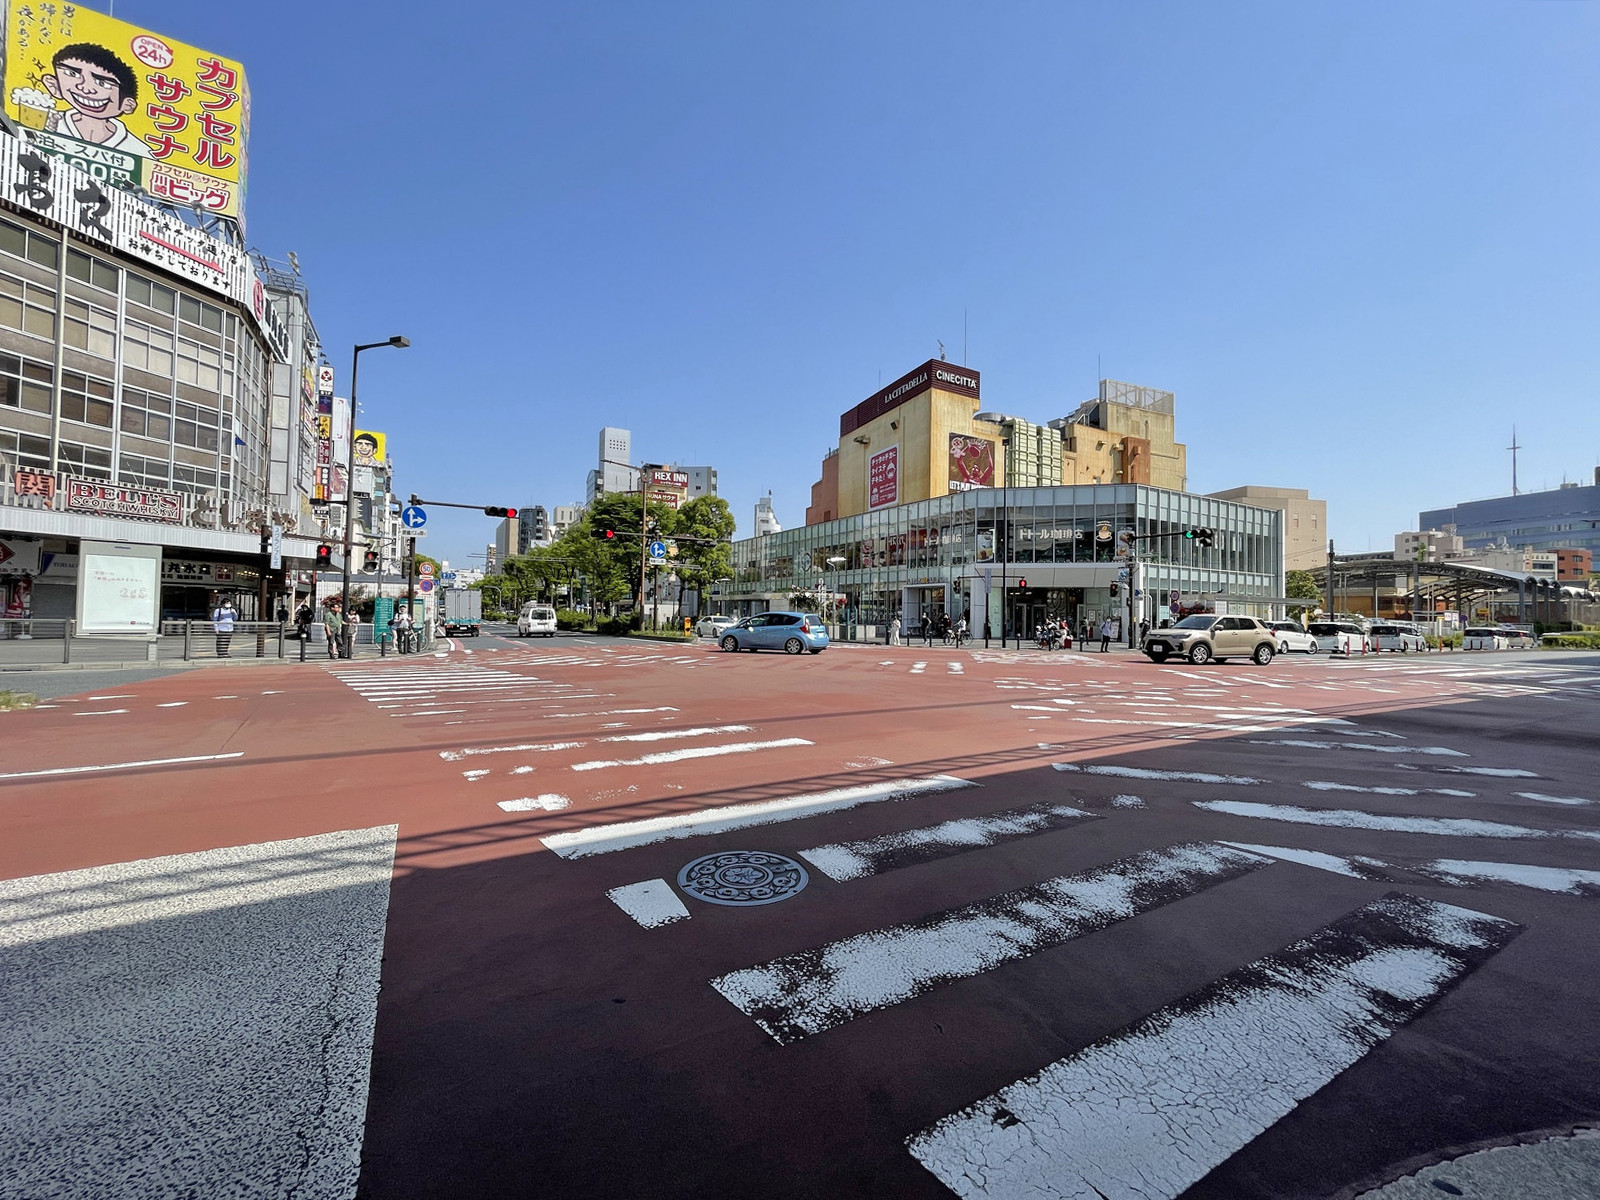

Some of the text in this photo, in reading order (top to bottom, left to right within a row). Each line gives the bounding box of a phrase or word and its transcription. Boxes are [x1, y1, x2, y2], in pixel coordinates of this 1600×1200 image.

[138, 45, 167, 65] 24h
[140, 38, 164, 52] OPEN
[144, 72, 191, 161] サウナ
[193, 57, 239, 169] カプセル
[654, 471, 688, 483] REX INN
[73, 483, 178, 510] BELL'S
[1019, 528, 1084, 540] ドトール珈琲店
